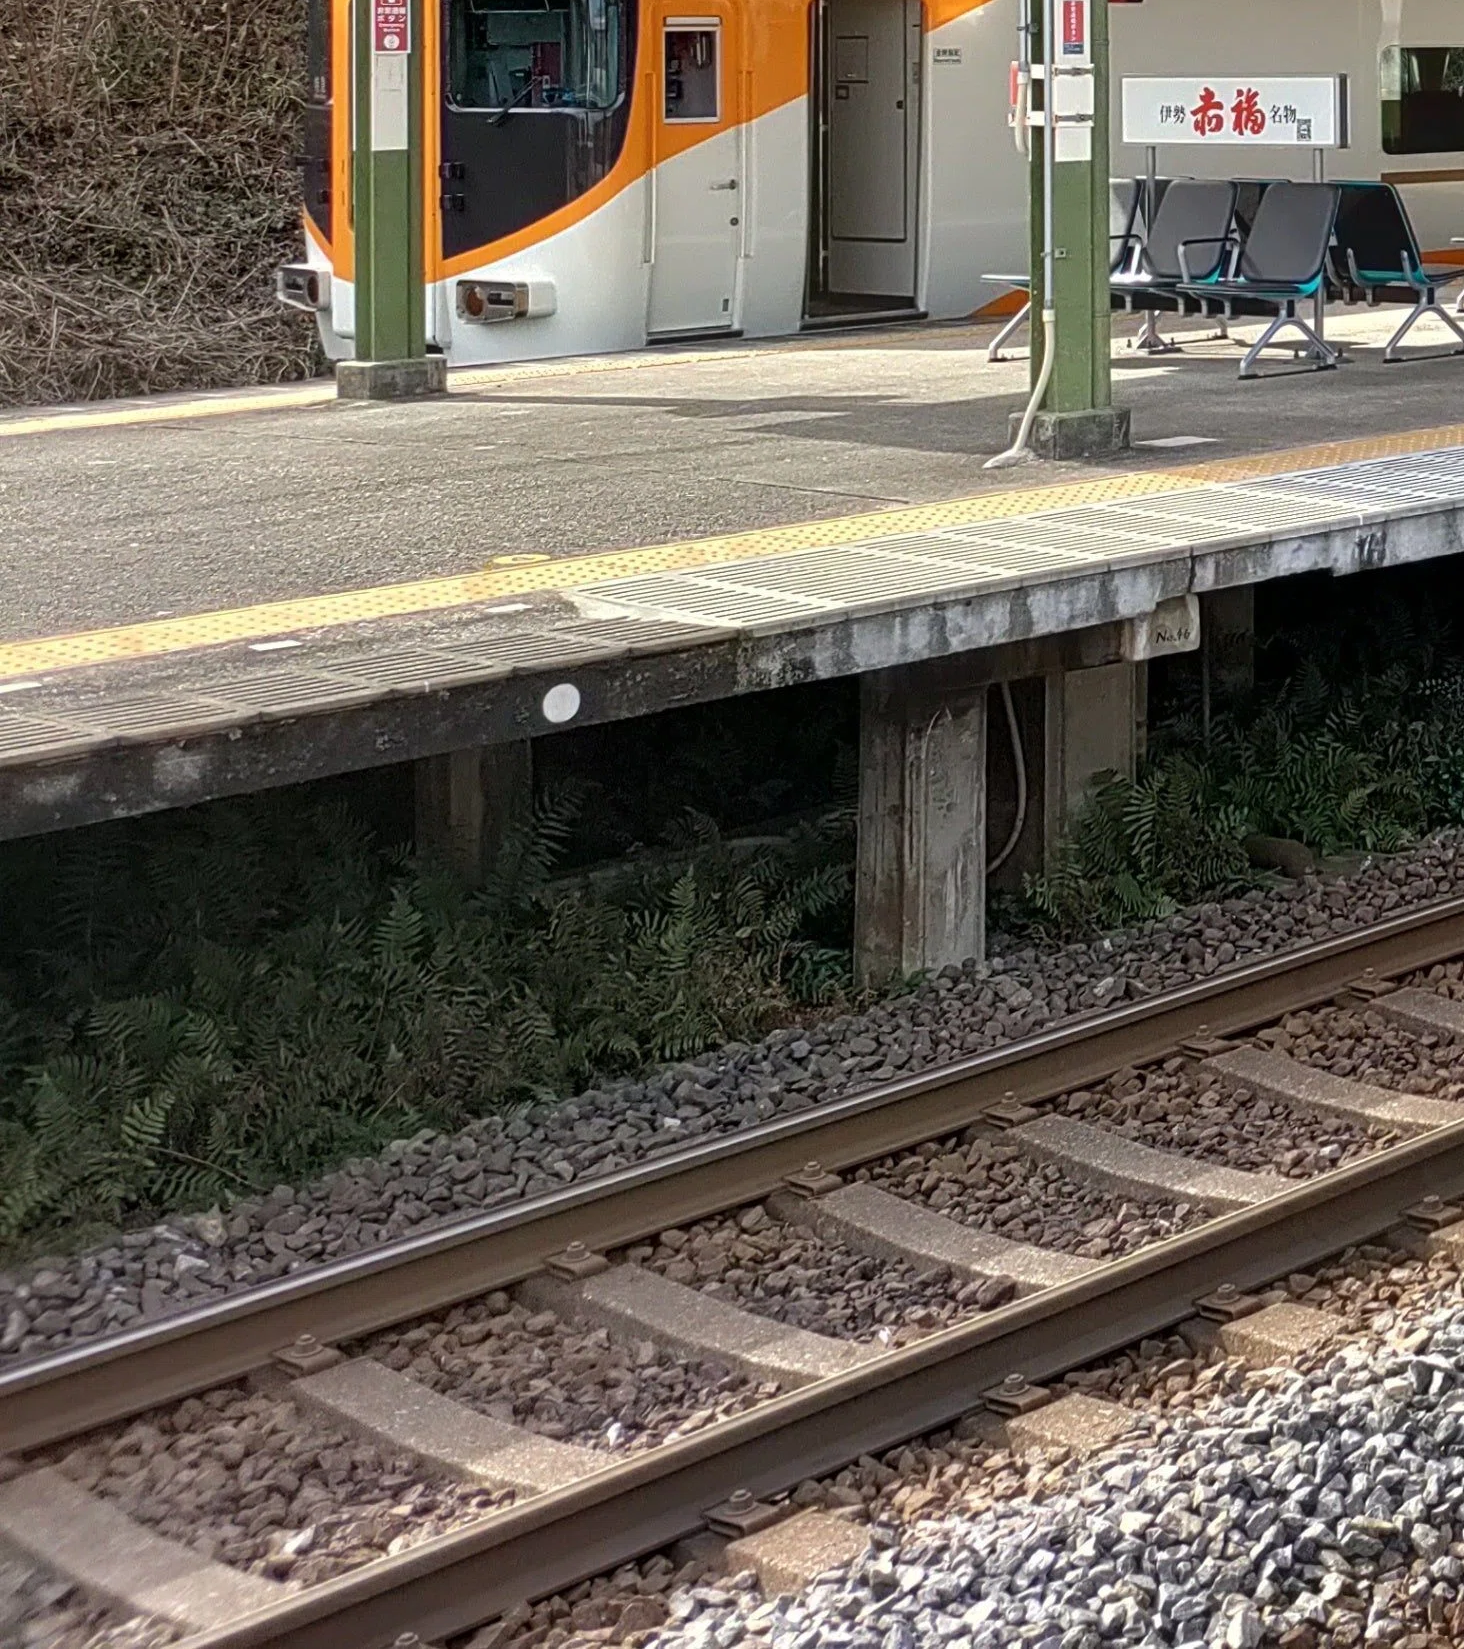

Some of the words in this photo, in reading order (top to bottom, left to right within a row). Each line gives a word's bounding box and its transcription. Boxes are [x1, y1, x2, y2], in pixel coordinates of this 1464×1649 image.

[1159, 104, 1186, 124] 伊勢
[1190, 86, 1266, 137] 赤福
[1269, 104, 1297, 124] 名物
